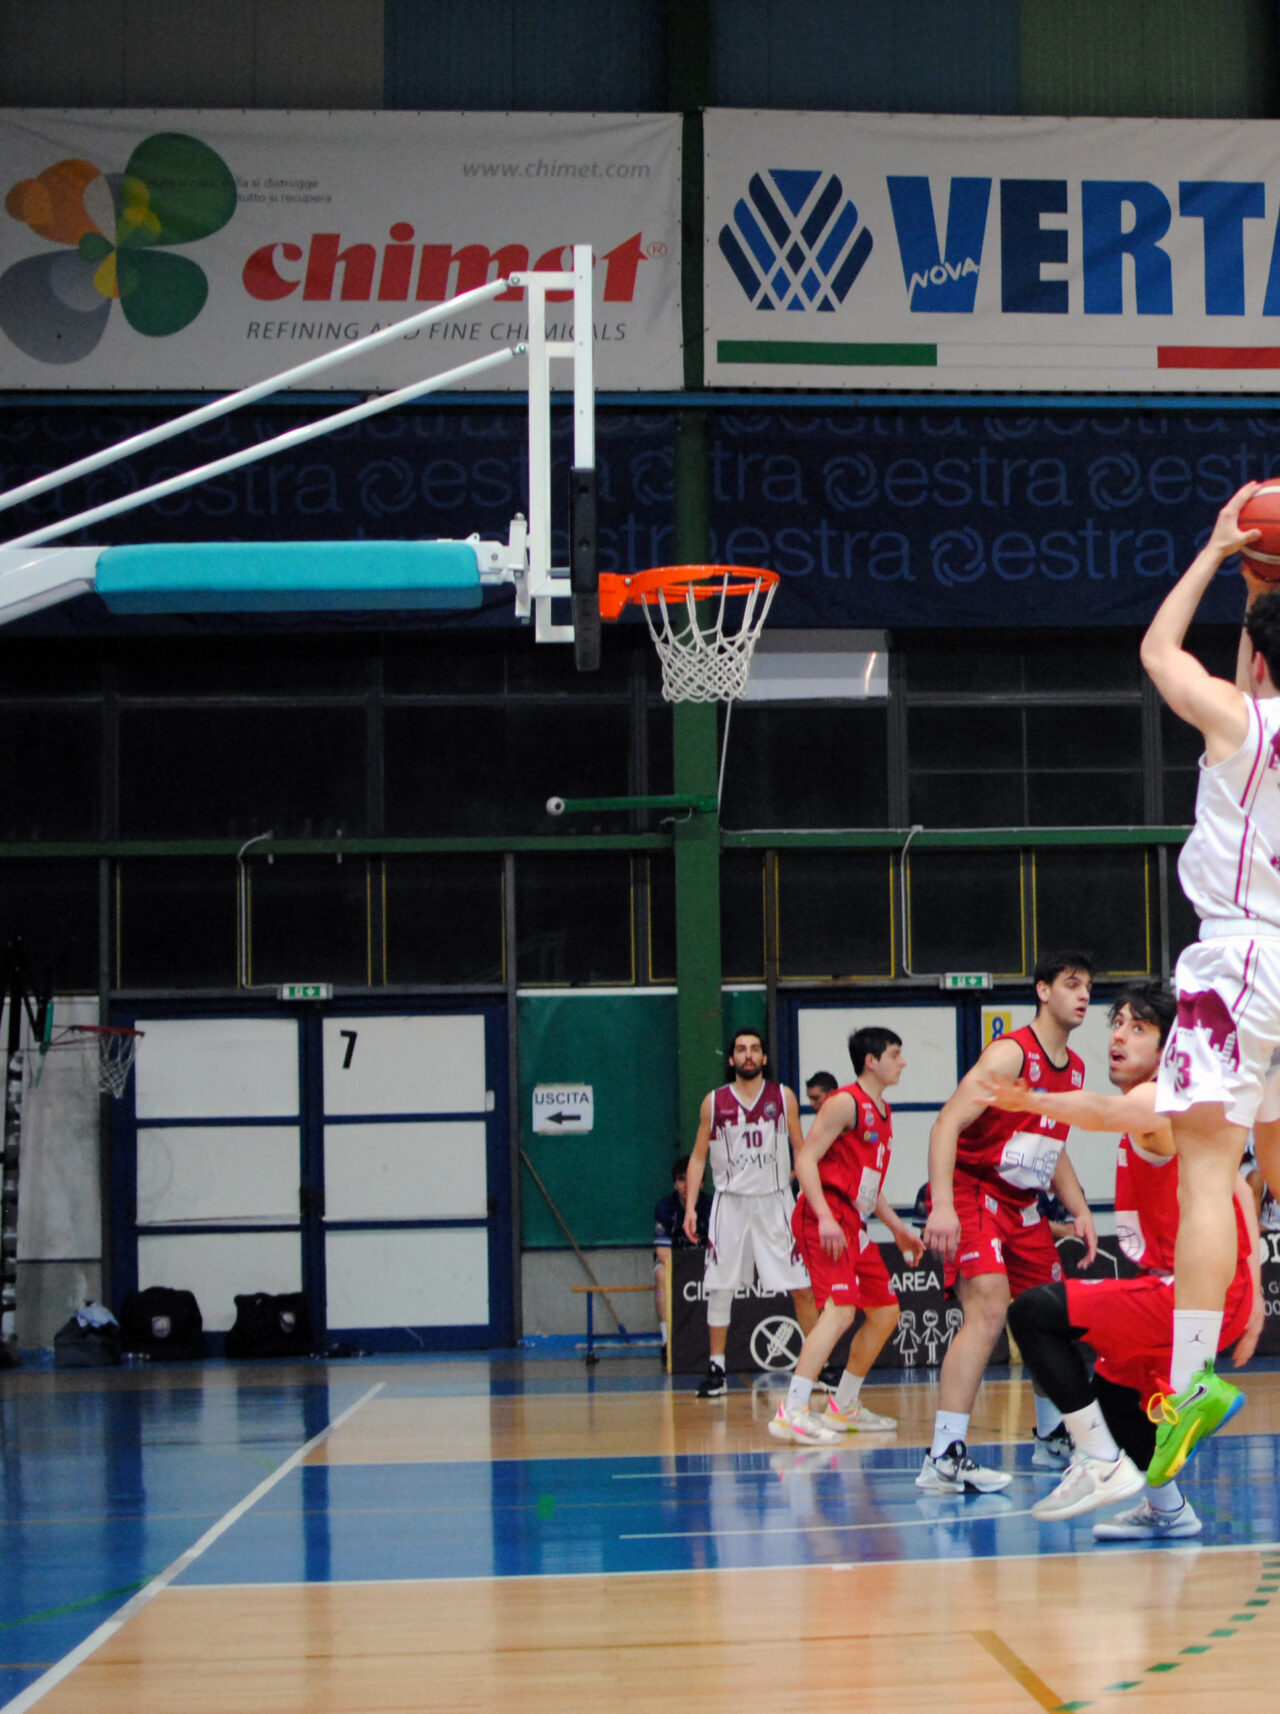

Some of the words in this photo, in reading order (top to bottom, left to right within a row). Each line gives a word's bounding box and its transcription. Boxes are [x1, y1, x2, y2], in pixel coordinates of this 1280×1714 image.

[462, 159, 651, 179] www.chimet.com
[241, 221, 649, 302] chimet
[907, 256, 981, 298] NOVA
[247, 321, 359, 340] REFINING
[428, 322, 482, 340] FINE
[490, 321, 627, 341] CHMILS
[884, 446, 1073, 507] estra
[725, 518, 916, 581] estra
[991, 518, 1180, 581] estra
[340, 1029, 358, 1070] 7
[534, 1092, 590, 1105] USCITA
[741, 1130, 764, 1150] 10
[890, 1270, 941, 1293] AREA
